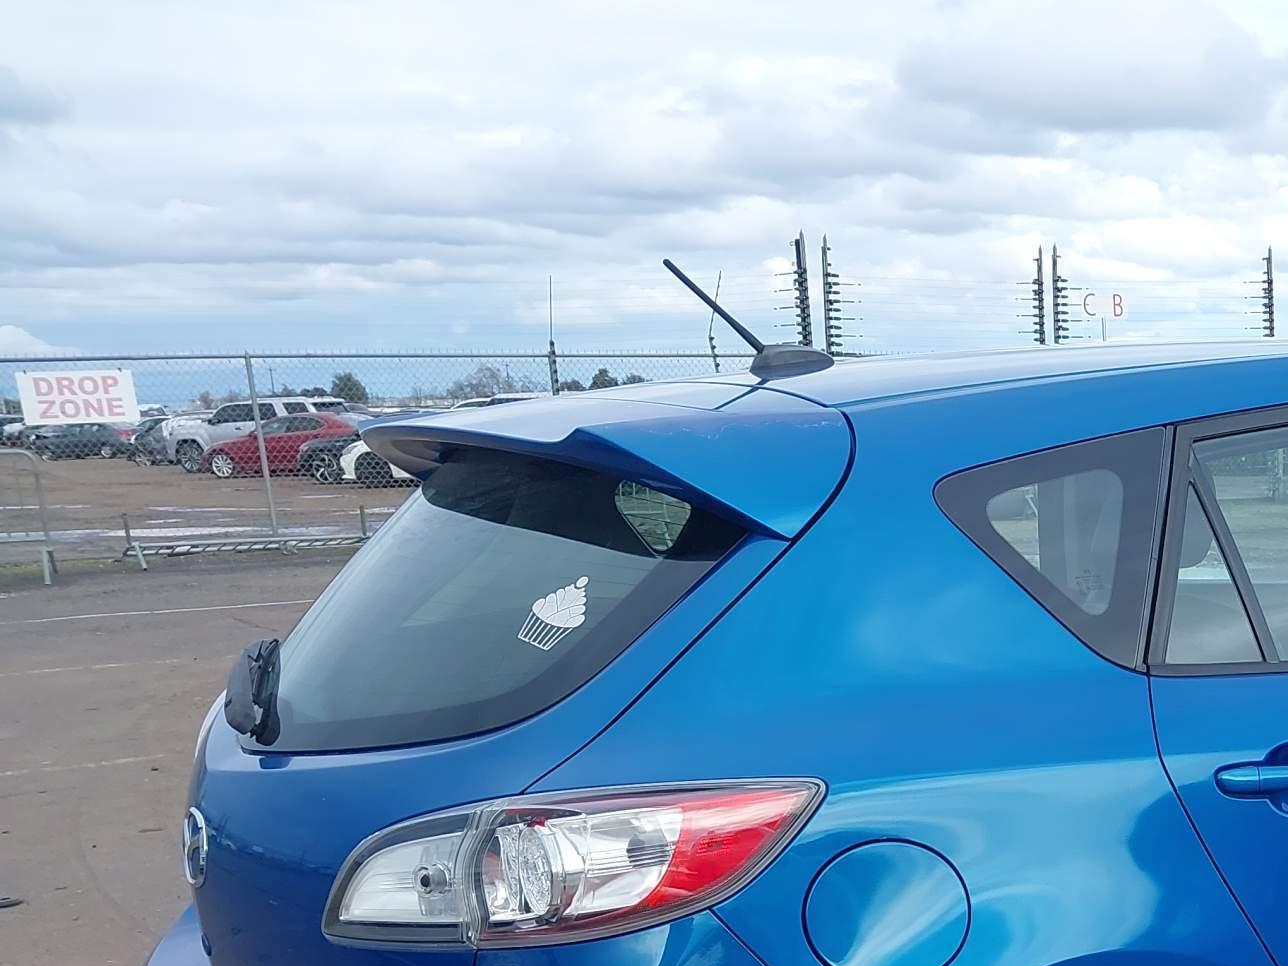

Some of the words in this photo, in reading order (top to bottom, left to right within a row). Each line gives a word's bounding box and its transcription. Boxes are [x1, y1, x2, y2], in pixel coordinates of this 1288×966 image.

[1083, 292, 1096, 316] C
[1112, 293, 1124, 317] B
[32, 375, 119, 397] DROP
[37, 397, 126, 419] ZONE
